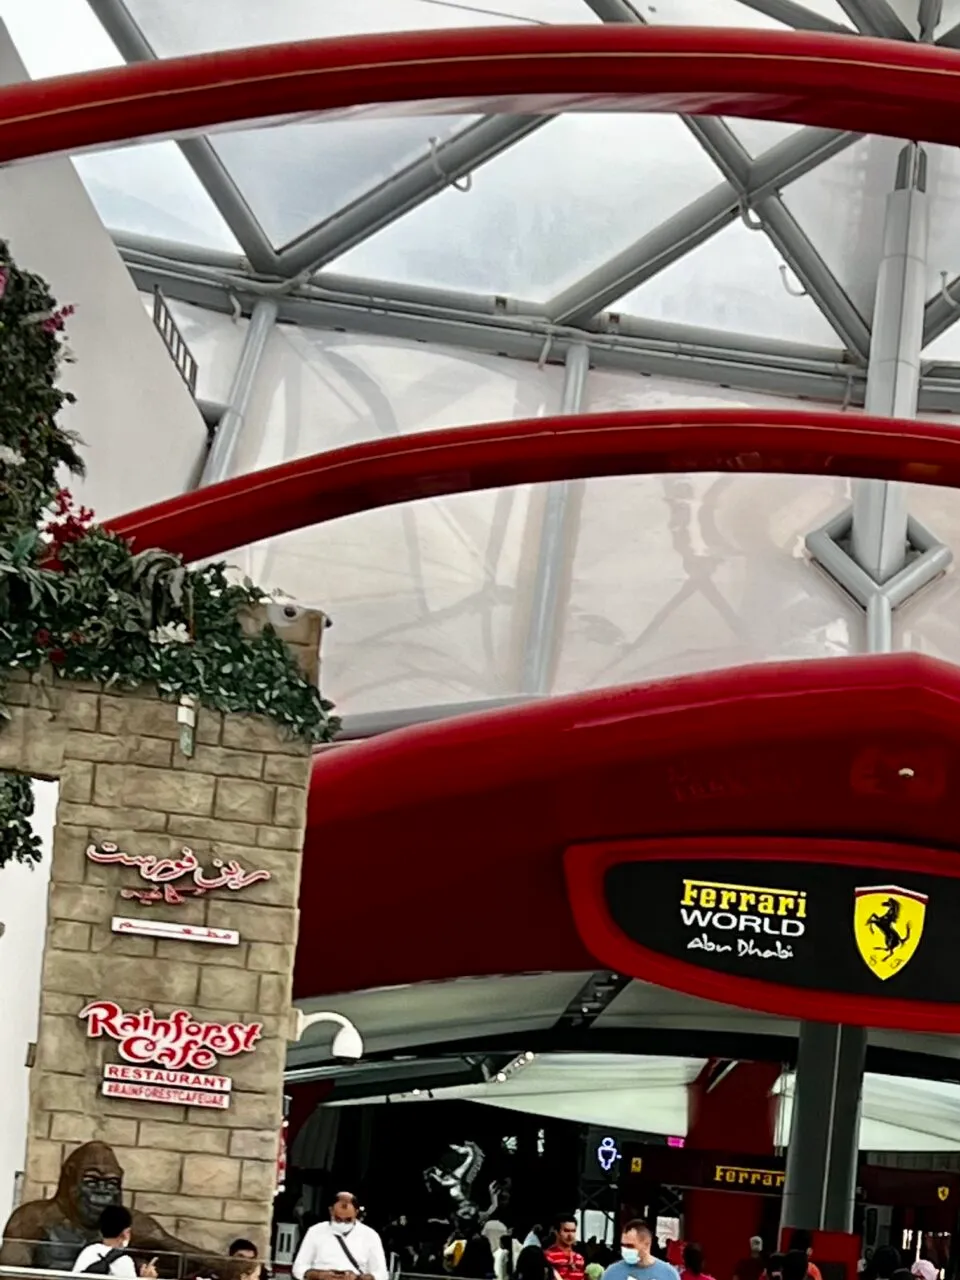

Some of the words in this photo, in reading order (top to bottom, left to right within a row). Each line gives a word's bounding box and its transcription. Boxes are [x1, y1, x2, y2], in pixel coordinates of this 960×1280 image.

[680, 879, 807, 918] Ferrari
[680, 908, 805, 937] WORLD
[687, 933, 732, 952] Abu
[737, 938, 794, 959] Dhabi
[79, 1000, 262, 1056] Rainforest
[119, 1035, 218, 1070] Cafe
[108, 1065, 228, 1089] RESTAURANT
[713, 1165, 785, 1187] Ferrar
